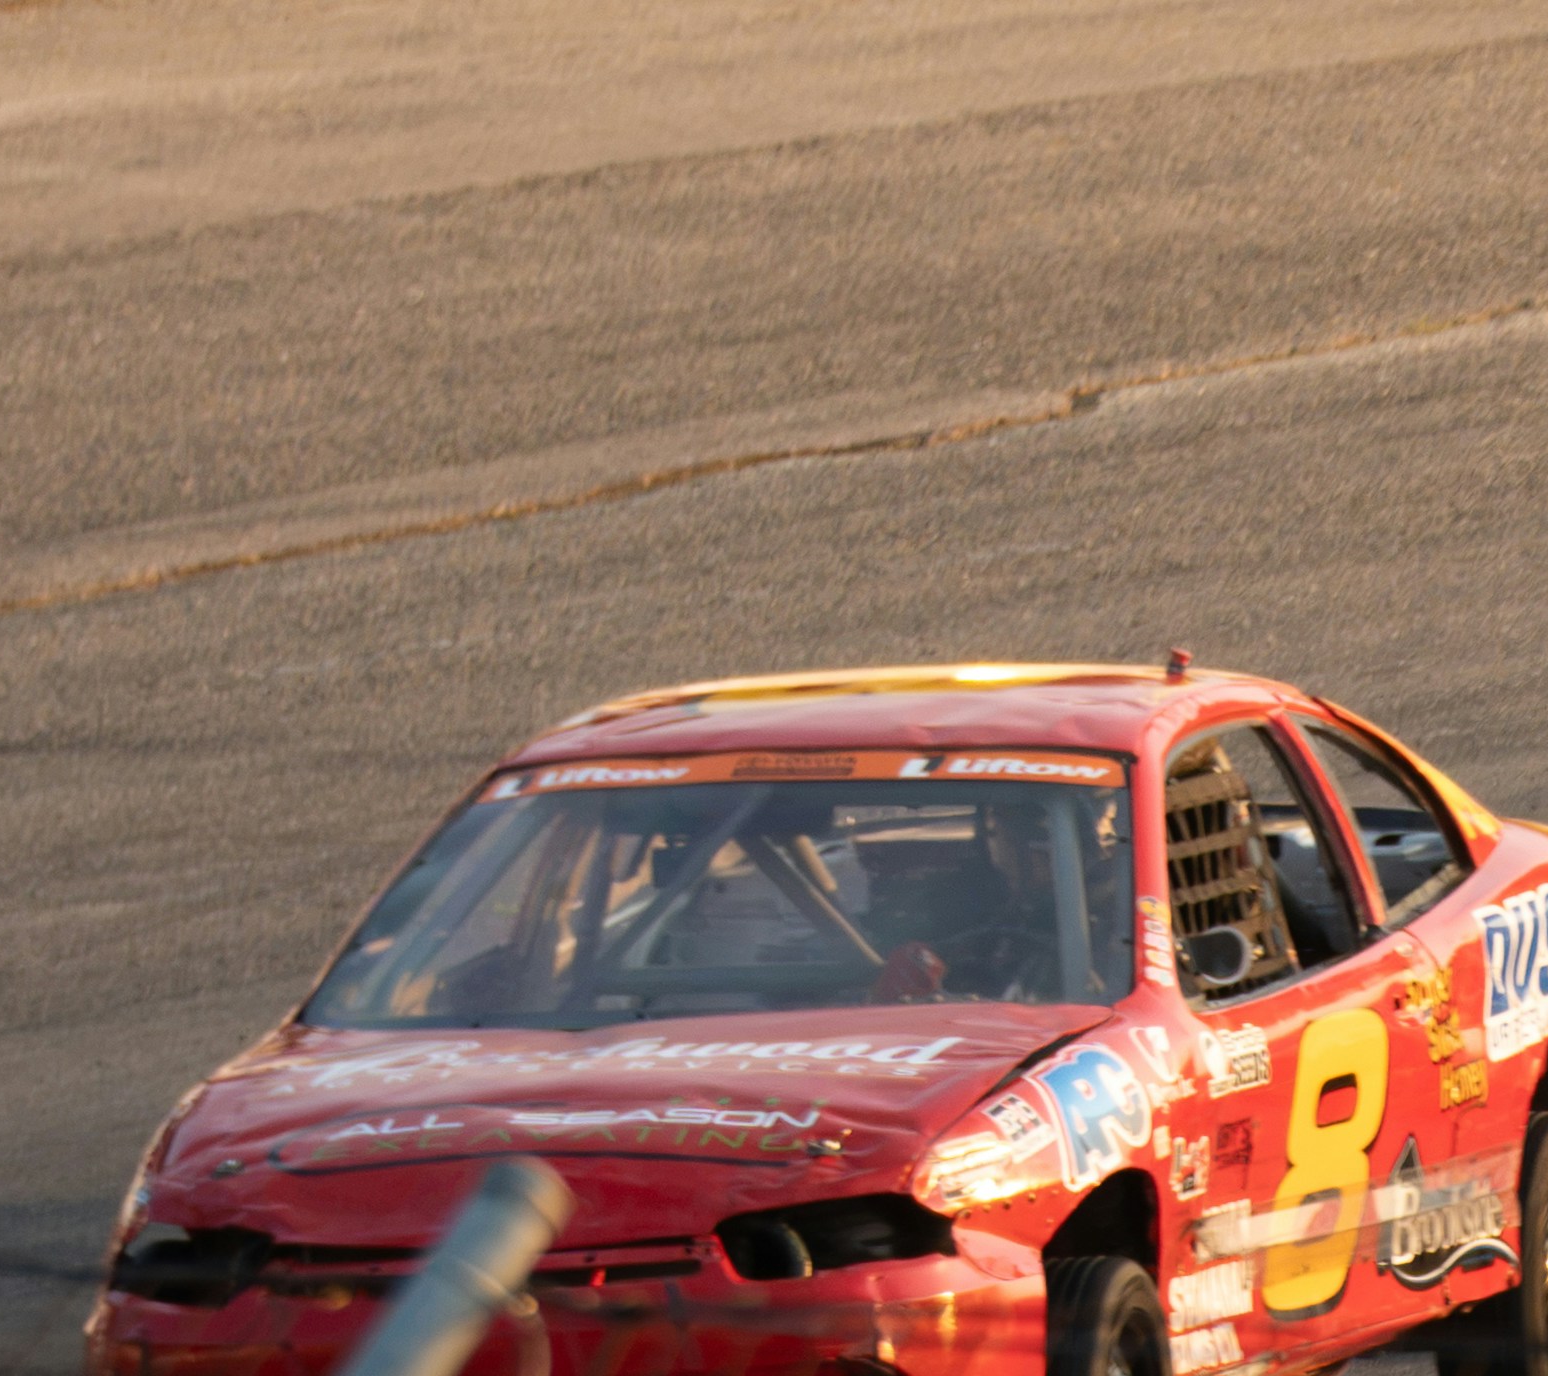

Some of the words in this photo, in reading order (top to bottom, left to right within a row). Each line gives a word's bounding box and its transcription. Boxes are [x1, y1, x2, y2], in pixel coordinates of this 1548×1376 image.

[539, 764, 691, 788] Liftow
[945, 757, 1112, 780] Liftow
[326, 1112, 465, 1141] ALL
[507, 1108, 821, 1129] SEASON
[1261, 1007, 1390, 1321] 8
